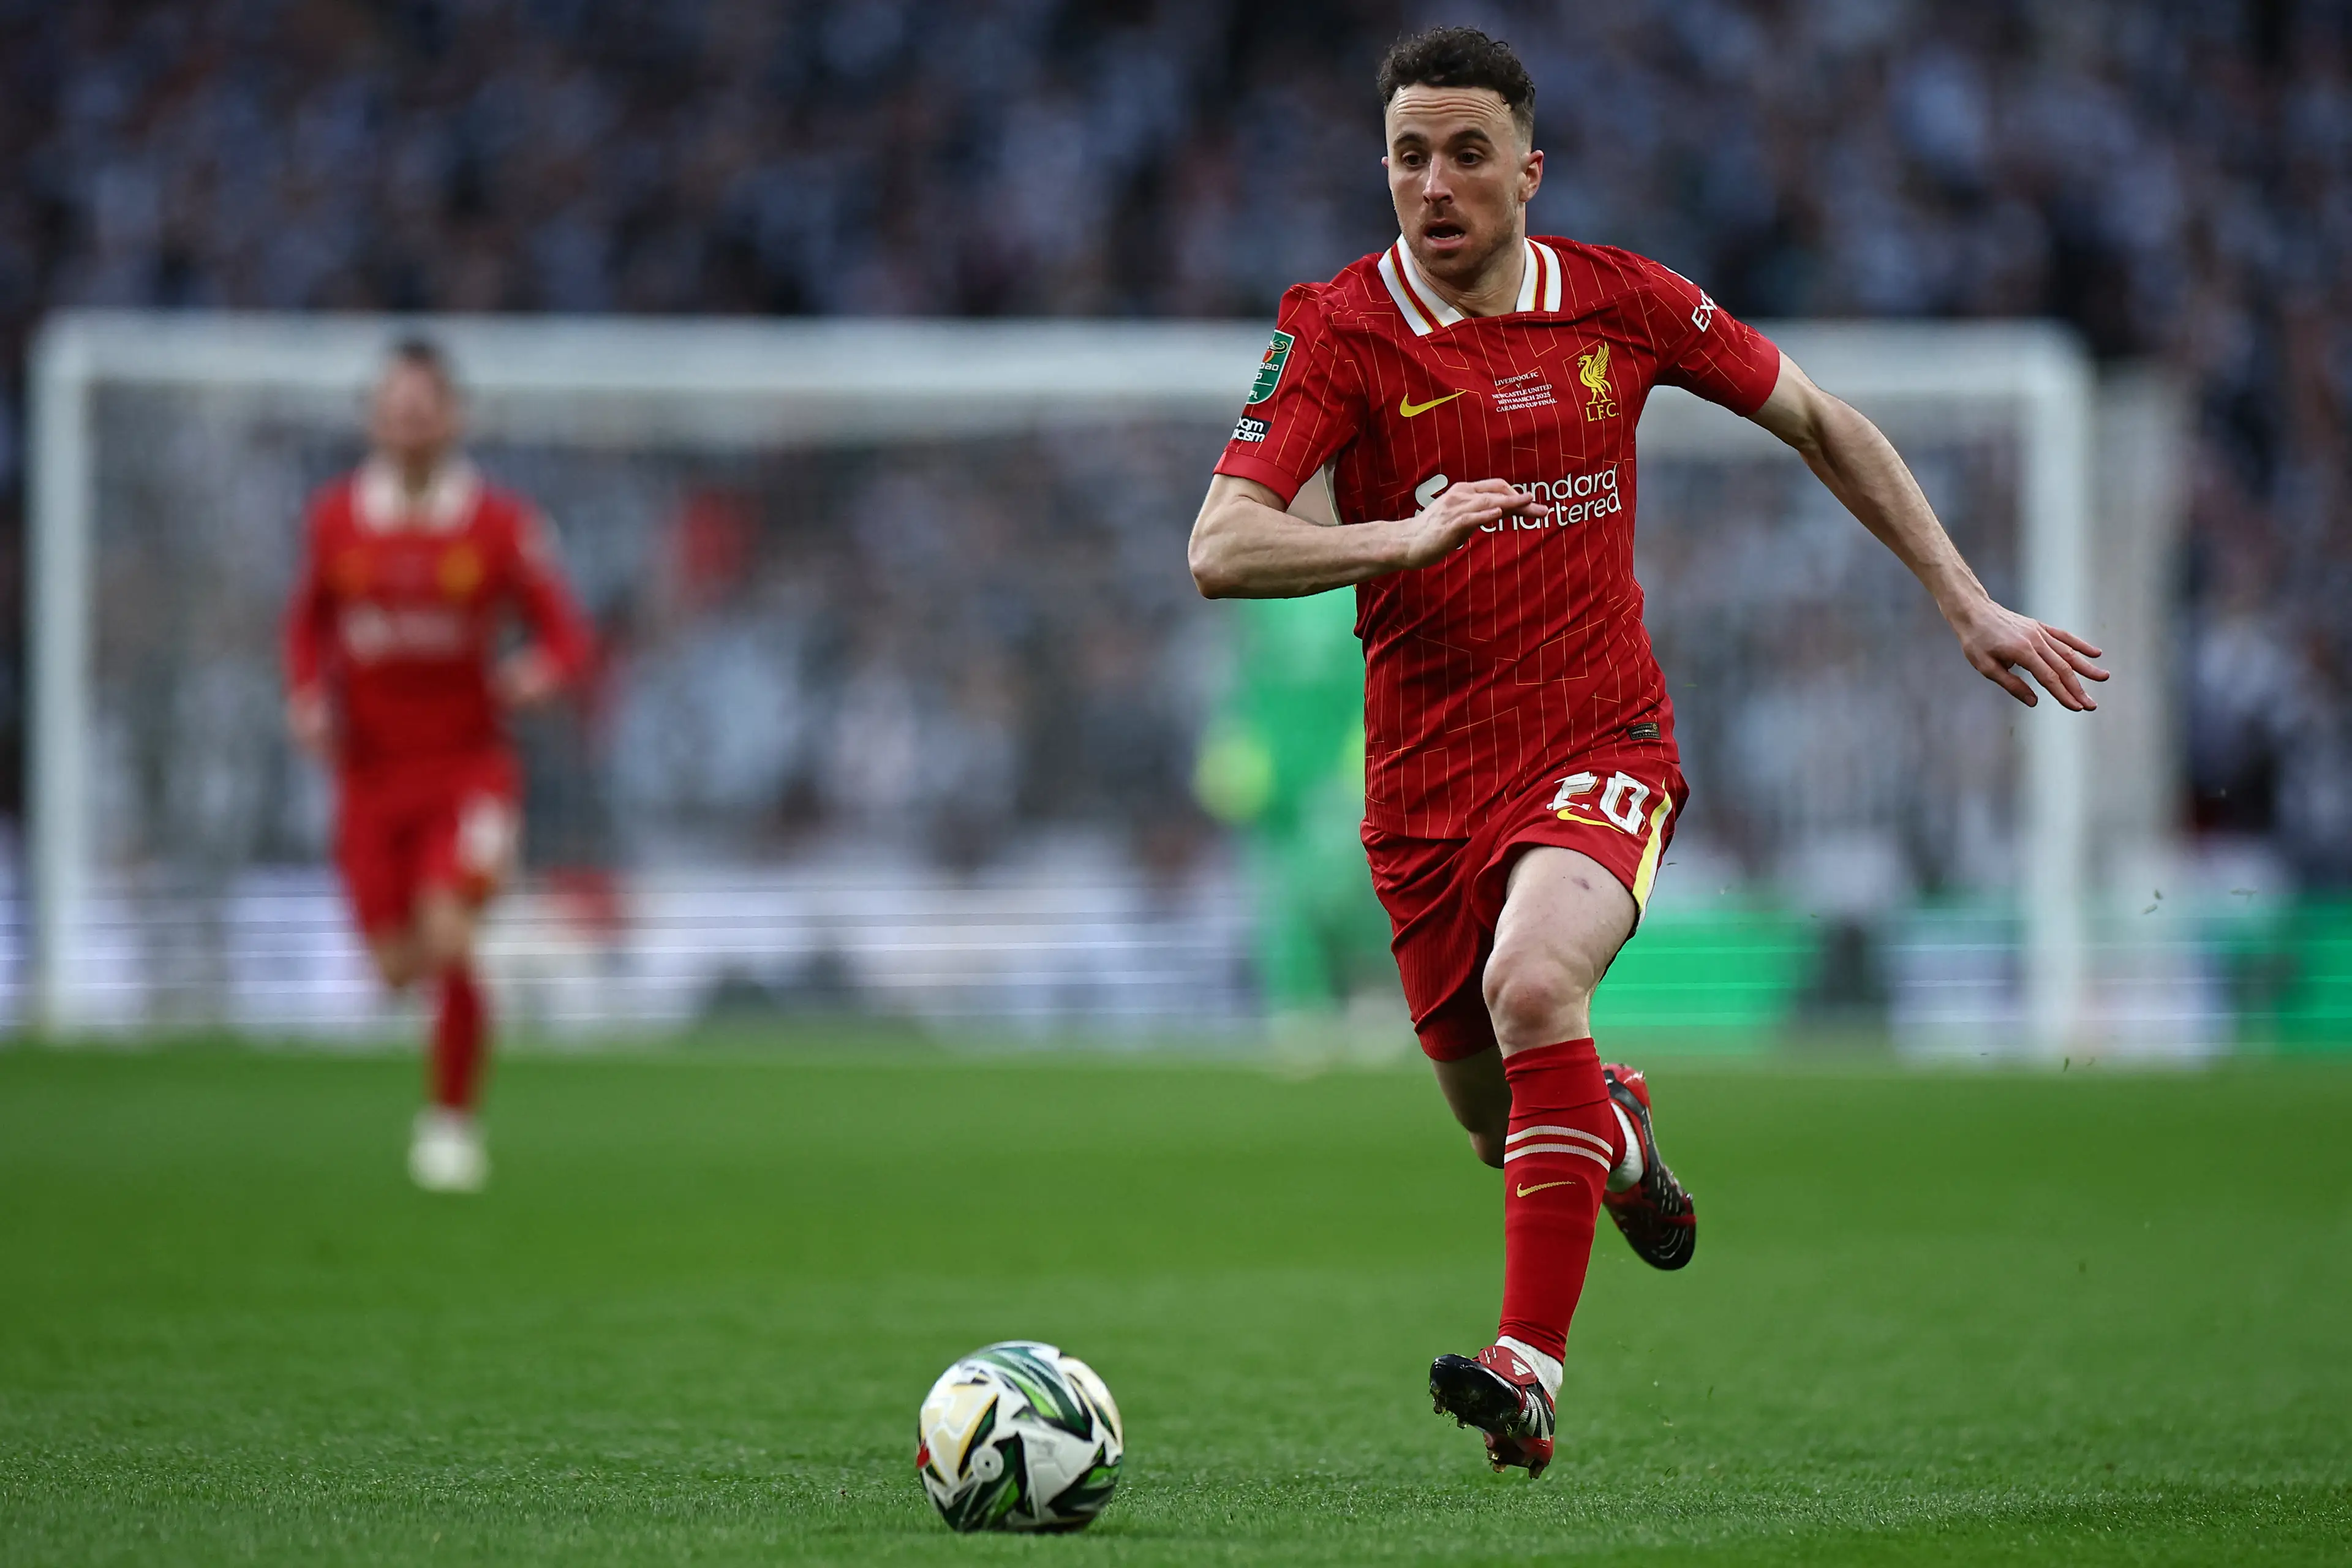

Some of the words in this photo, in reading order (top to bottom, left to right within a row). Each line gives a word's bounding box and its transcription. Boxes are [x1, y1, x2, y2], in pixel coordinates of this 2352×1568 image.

[1494, 374, 1530, 386] LIVERPOOL
[1491, 390, 1527, 399] NEWCASTLE
[1528, 384, 1552, 394] UNITED
[1512, 394, 1536, 403] MARCH
[1536, 391, 1551, 400] 2025
[1496, 403, 1525, 412] CARABAO
[1546, 771, 1650, 837] 20
